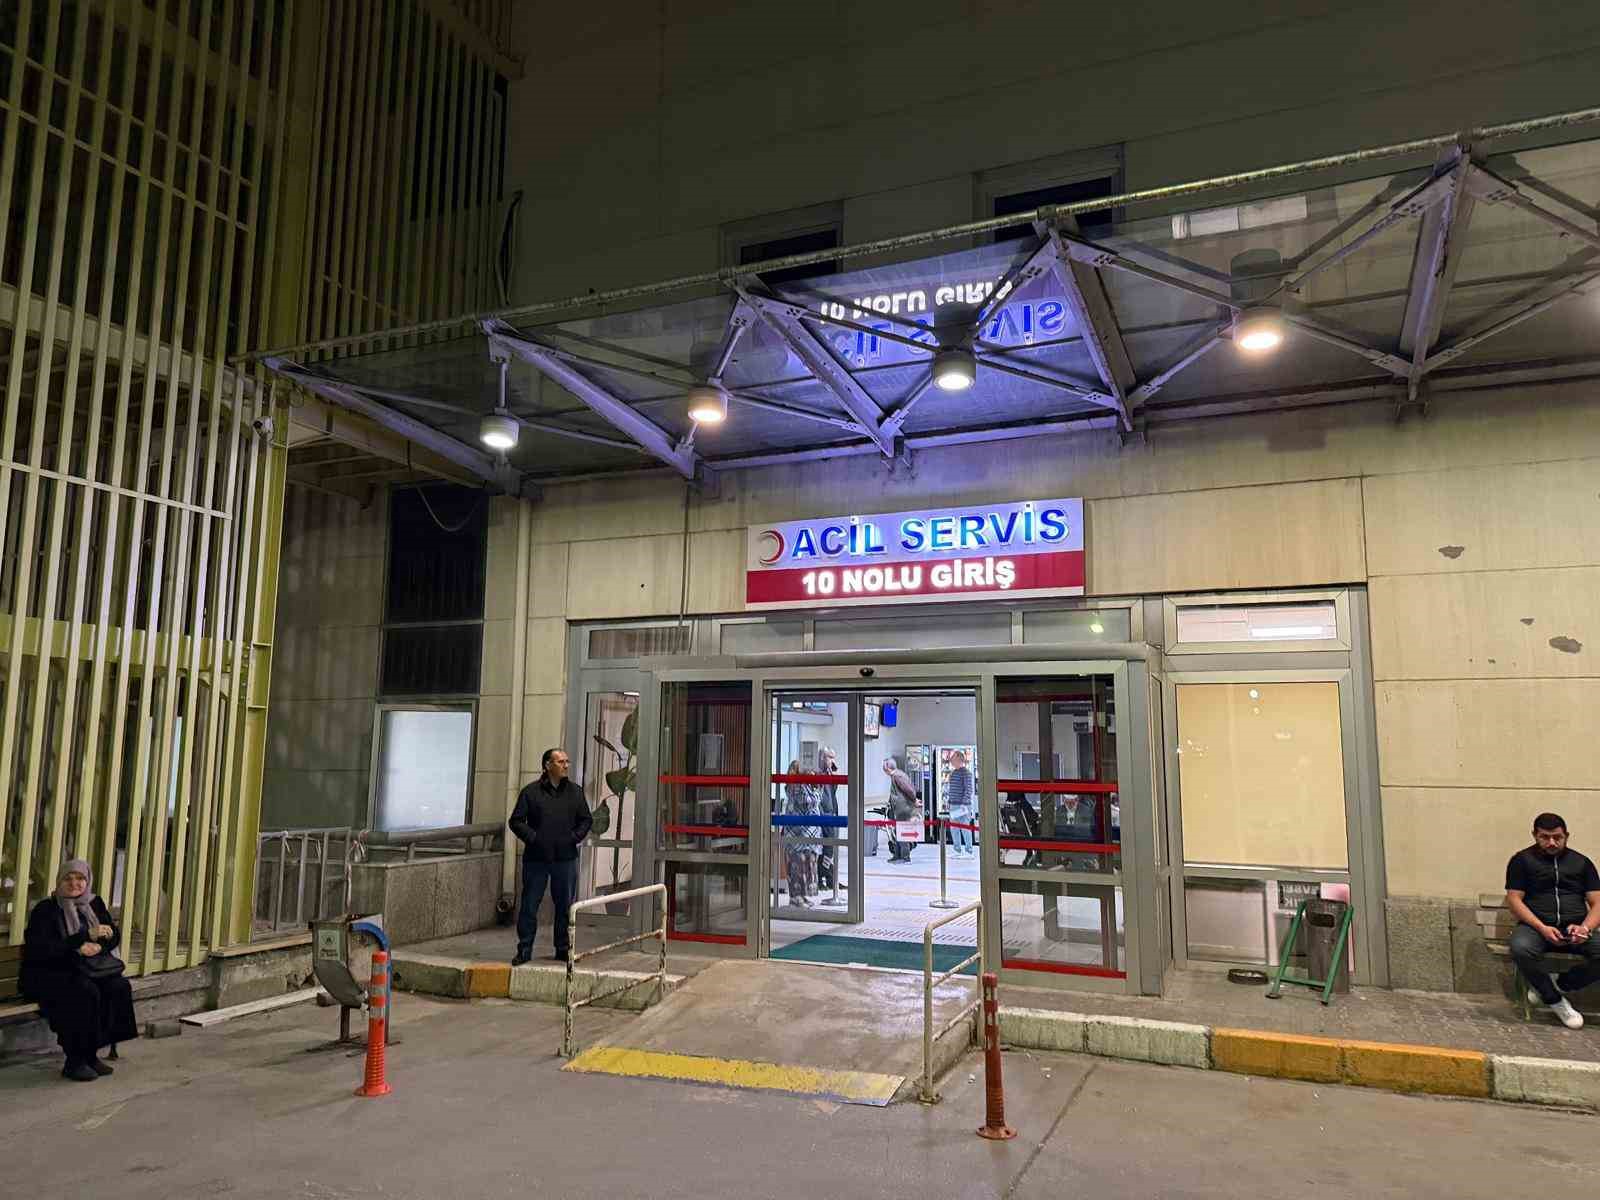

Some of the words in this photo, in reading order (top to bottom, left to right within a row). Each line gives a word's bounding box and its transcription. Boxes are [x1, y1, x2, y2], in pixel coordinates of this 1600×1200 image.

[792, 515, 887, 560] ACİL
[900, 503, 1070, 553] SERVİS
[802, 571, 836, 595] 10
[842, 565, 922, 593] NOLU
[930, 557, 1016, 589] GİRİŞ
